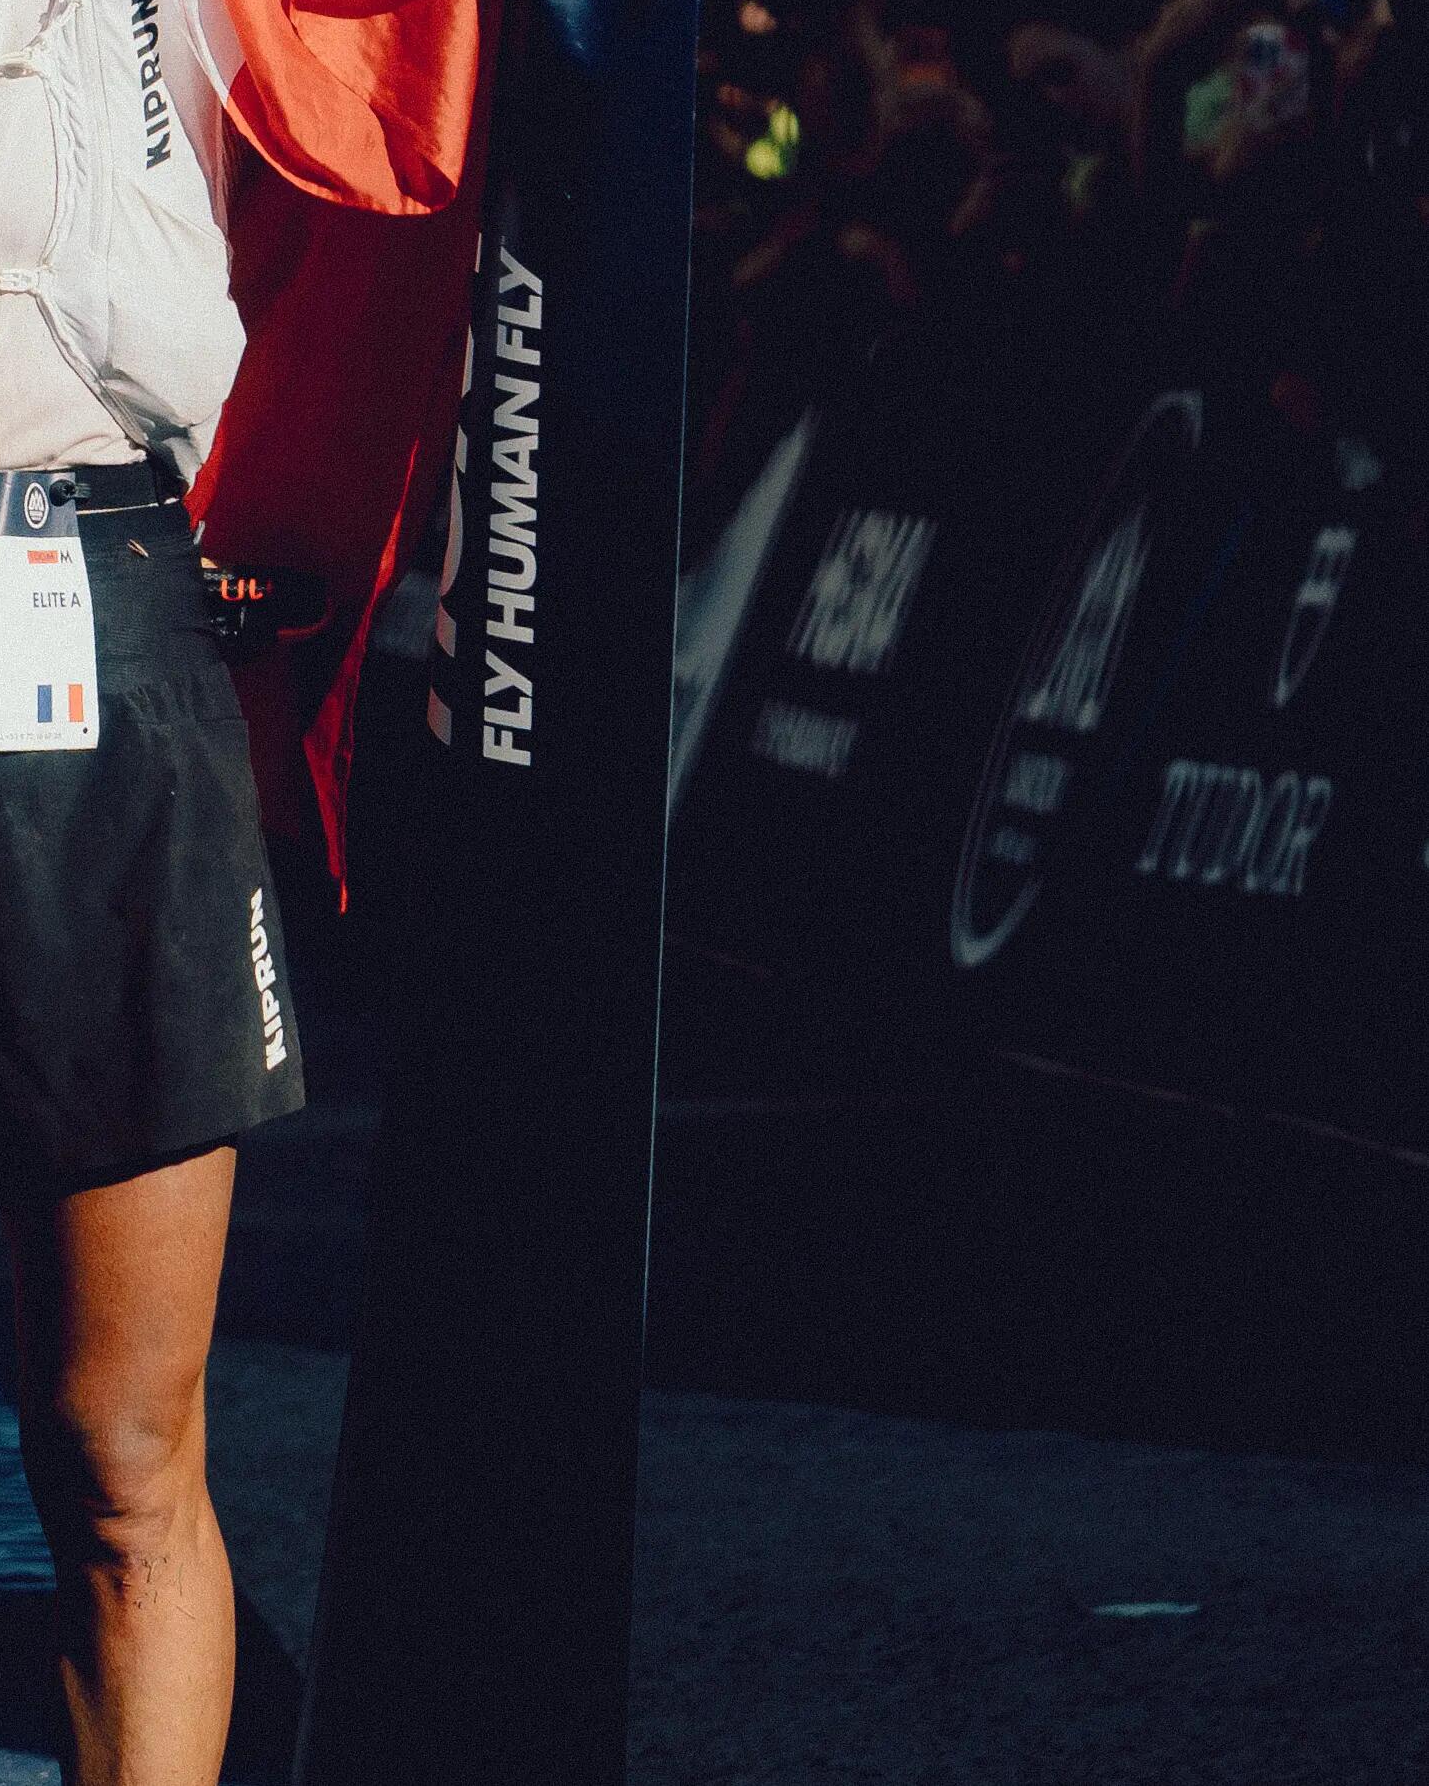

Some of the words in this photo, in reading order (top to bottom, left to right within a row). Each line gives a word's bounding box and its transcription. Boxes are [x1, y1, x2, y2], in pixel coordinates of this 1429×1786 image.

[495, 245, 543, 366] FLY
[485, 374, 540, 644] HUMAN
[33, 592, 68, 608] ELITE
[70, 592, 81, 608] A
[482, 648, 533, 767] FLY
[250, 887, 288, 1071] KIPRUN
